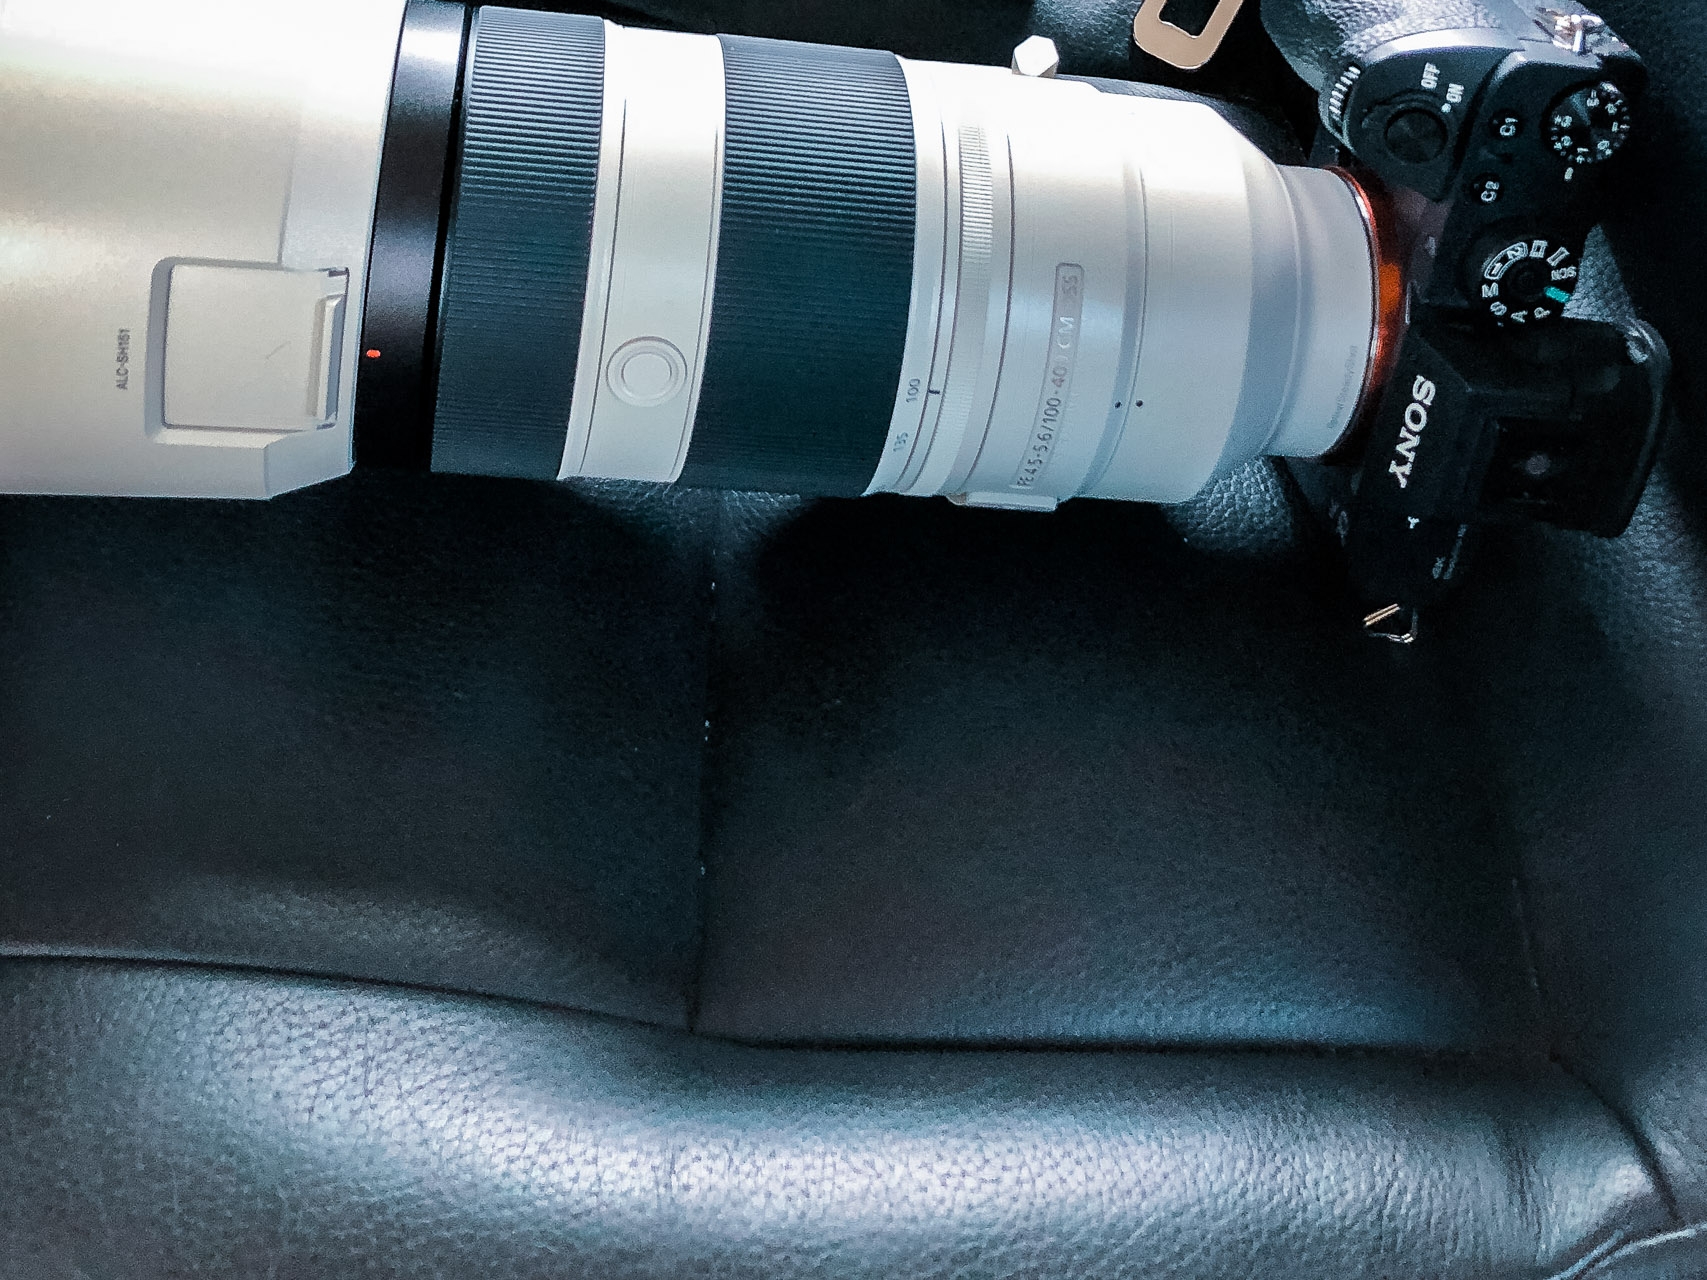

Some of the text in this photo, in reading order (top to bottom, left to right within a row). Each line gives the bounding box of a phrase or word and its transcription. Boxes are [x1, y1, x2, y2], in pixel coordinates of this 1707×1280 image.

[1500, 117, 1518, 137] C1
[1481, 181, 1500, 203] C2
[1482, 282, 1499, 298] M
[906, 378, 921, 403] 100
[892, 432, 910, 452] 135
[1388, 374, 1437, 489] SONY
